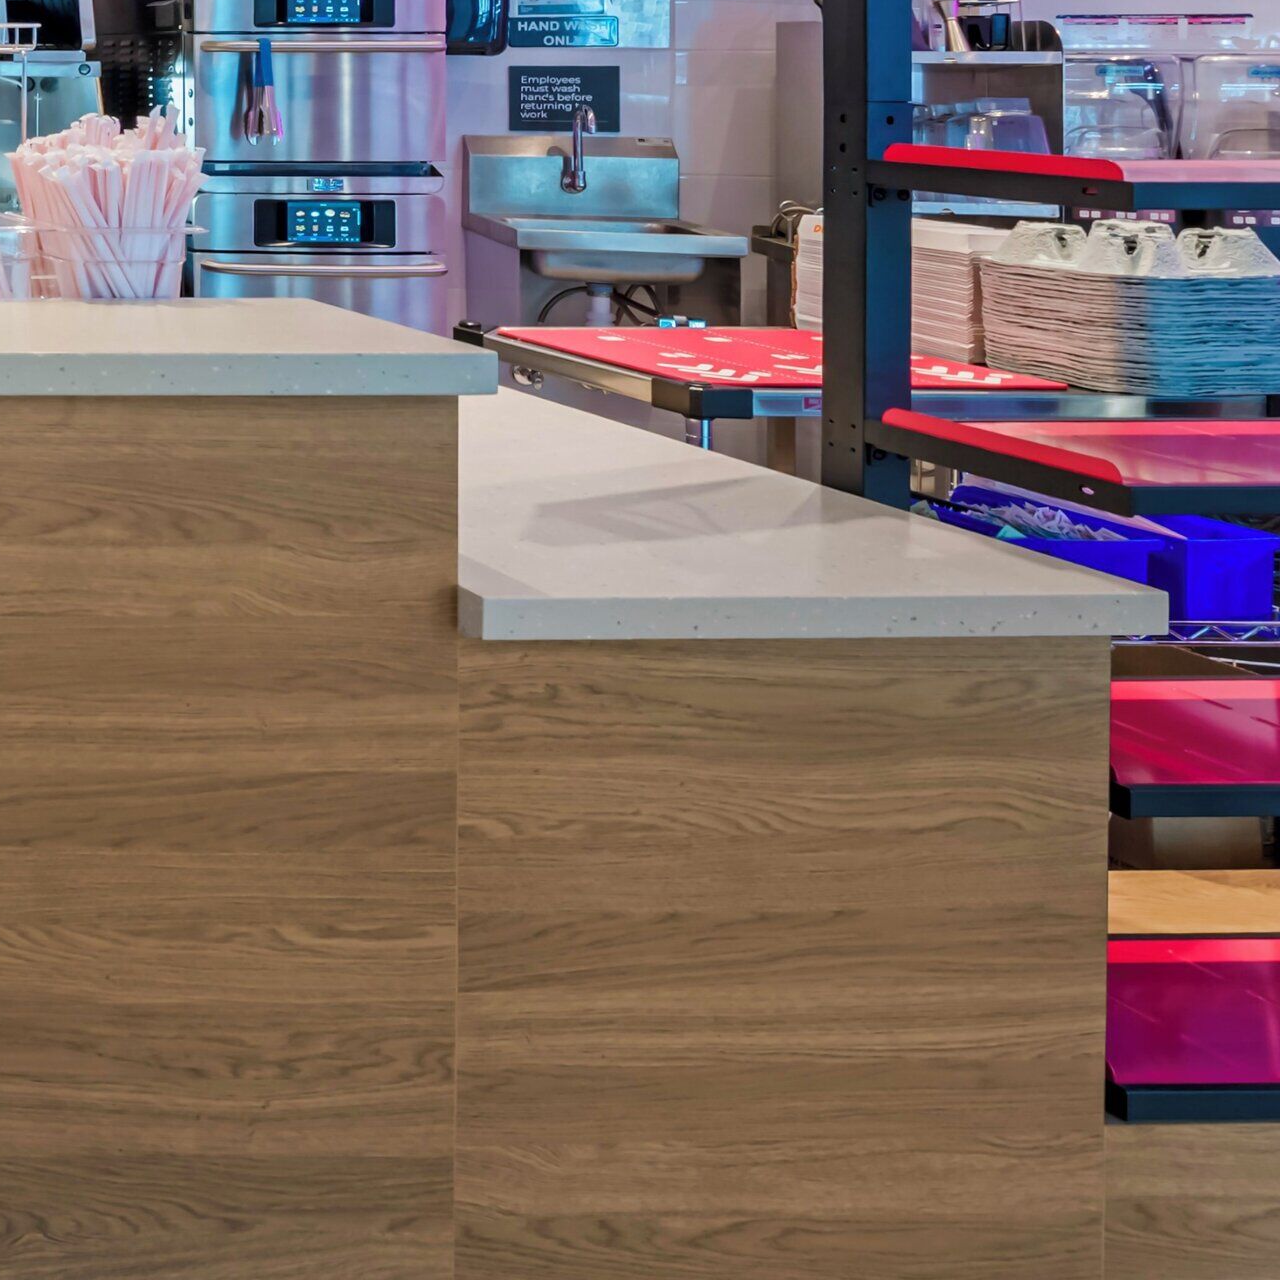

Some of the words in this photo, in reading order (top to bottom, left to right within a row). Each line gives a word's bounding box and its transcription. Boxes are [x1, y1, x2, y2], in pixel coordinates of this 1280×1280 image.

[517, 21, 560, 32] HAND
[520, 75, 582, 86] Employees
[520, 84, 549, 93] must
[551, 84, 581, 93] wash
[520, 92, 555, 102] hands
[556, 92, 593, 102] before
[520, 102, 573, 112] returning
[520, 111, 548, 119] work
